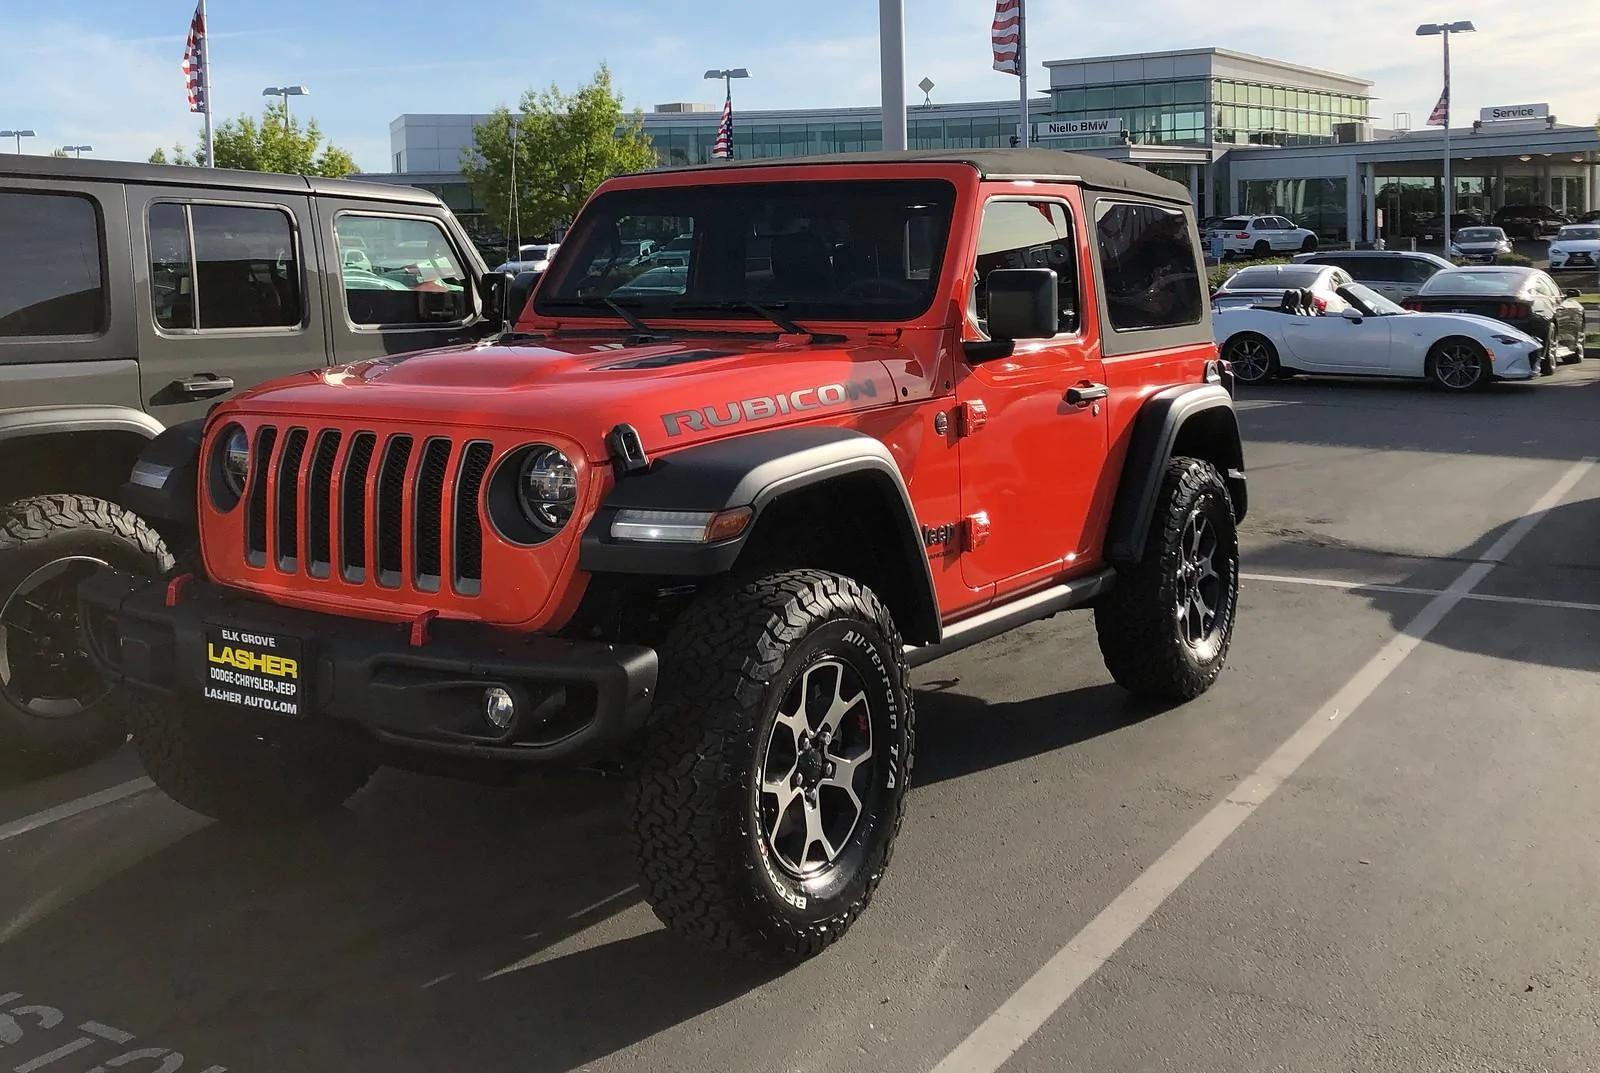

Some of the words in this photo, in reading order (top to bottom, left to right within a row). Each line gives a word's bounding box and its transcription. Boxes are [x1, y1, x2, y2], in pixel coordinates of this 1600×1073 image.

[1492, 107, 1534, 118] Service
[1049, 122, 1078, 133] Niello
[1080, 121, 1108, 131] BMW
[661, 378, 878, 437] RUBICON
[222, 629, 240, 642] ELK
[241, 633, 276, 648] GROVE
[208, 643, 298, 679] LASHER
[204, 687, 242, 704] LASHER
[244, 695, 297, 715] AUTO.COM
[842, 630, 898, 730] All-Terrain
[886, 743, 899, 789] T/A
